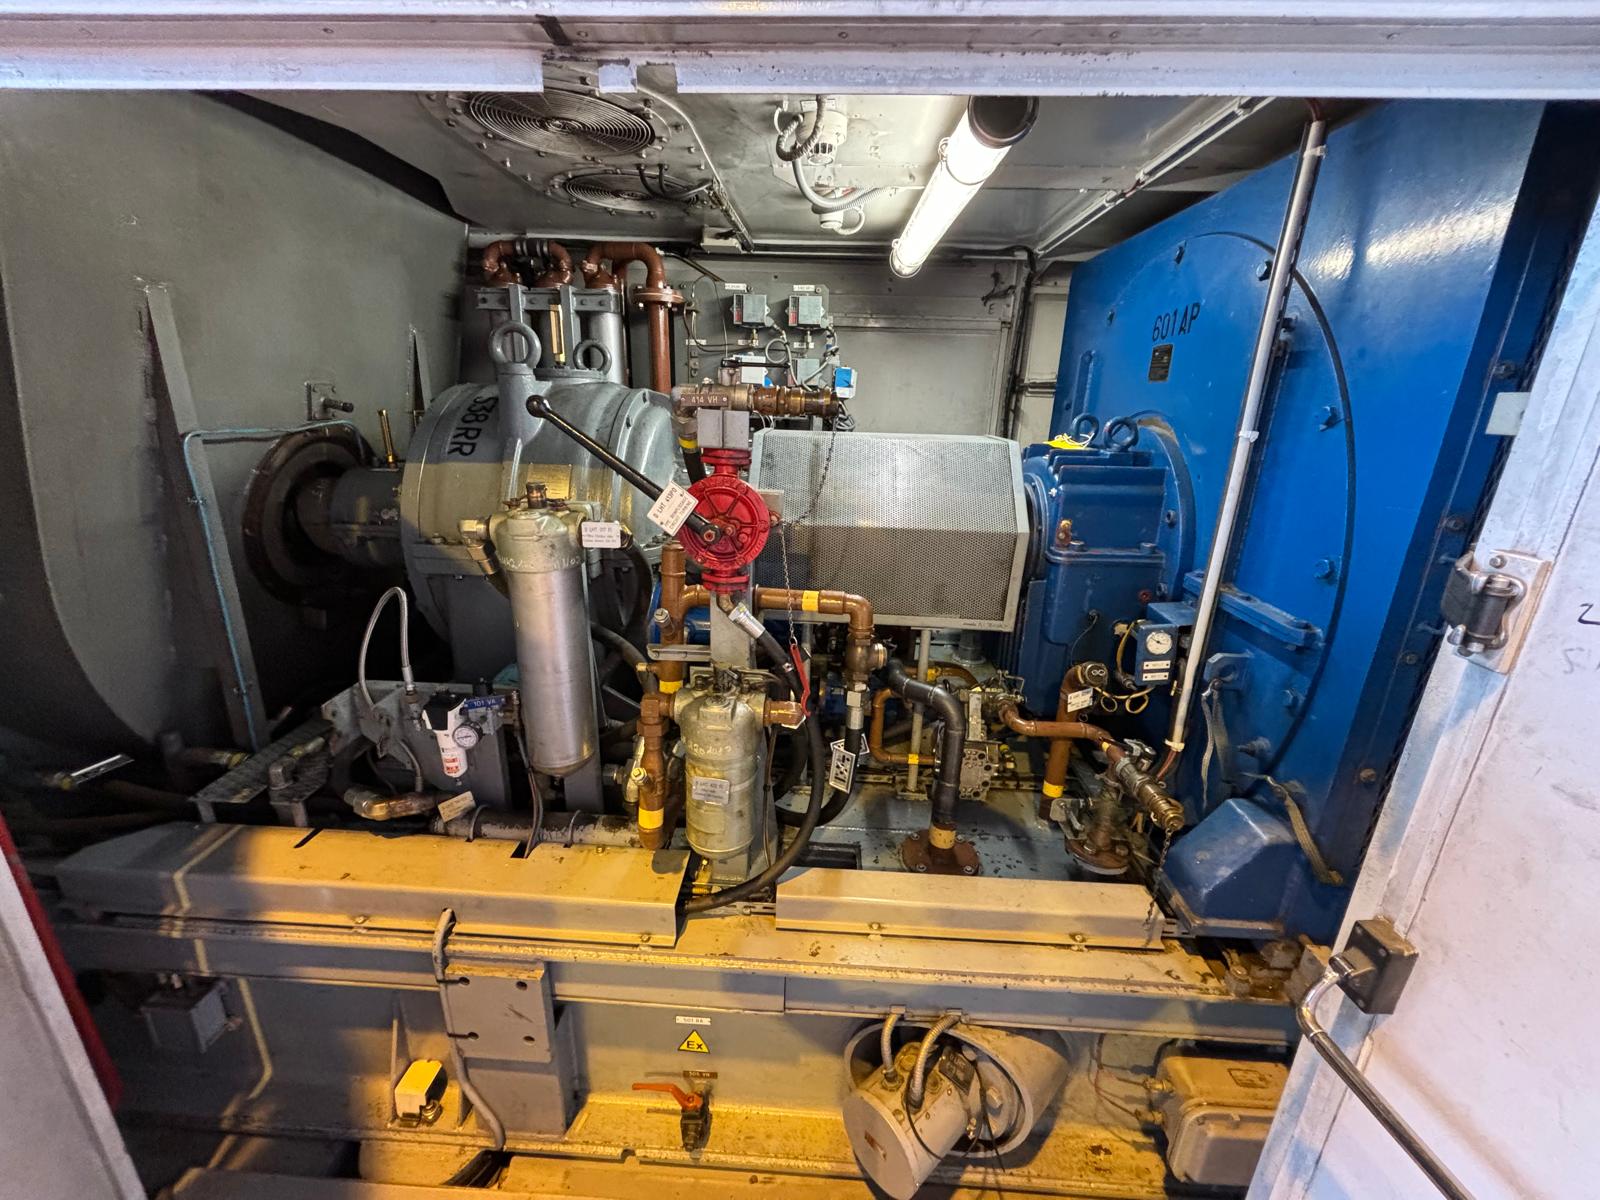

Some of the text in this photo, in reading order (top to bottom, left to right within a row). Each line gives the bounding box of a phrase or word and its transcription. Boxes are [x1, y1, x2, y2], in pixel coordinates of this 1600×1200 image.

[691, 395, 718, 404] 414 VH
[687, 1041, 703, 1050] Ex
